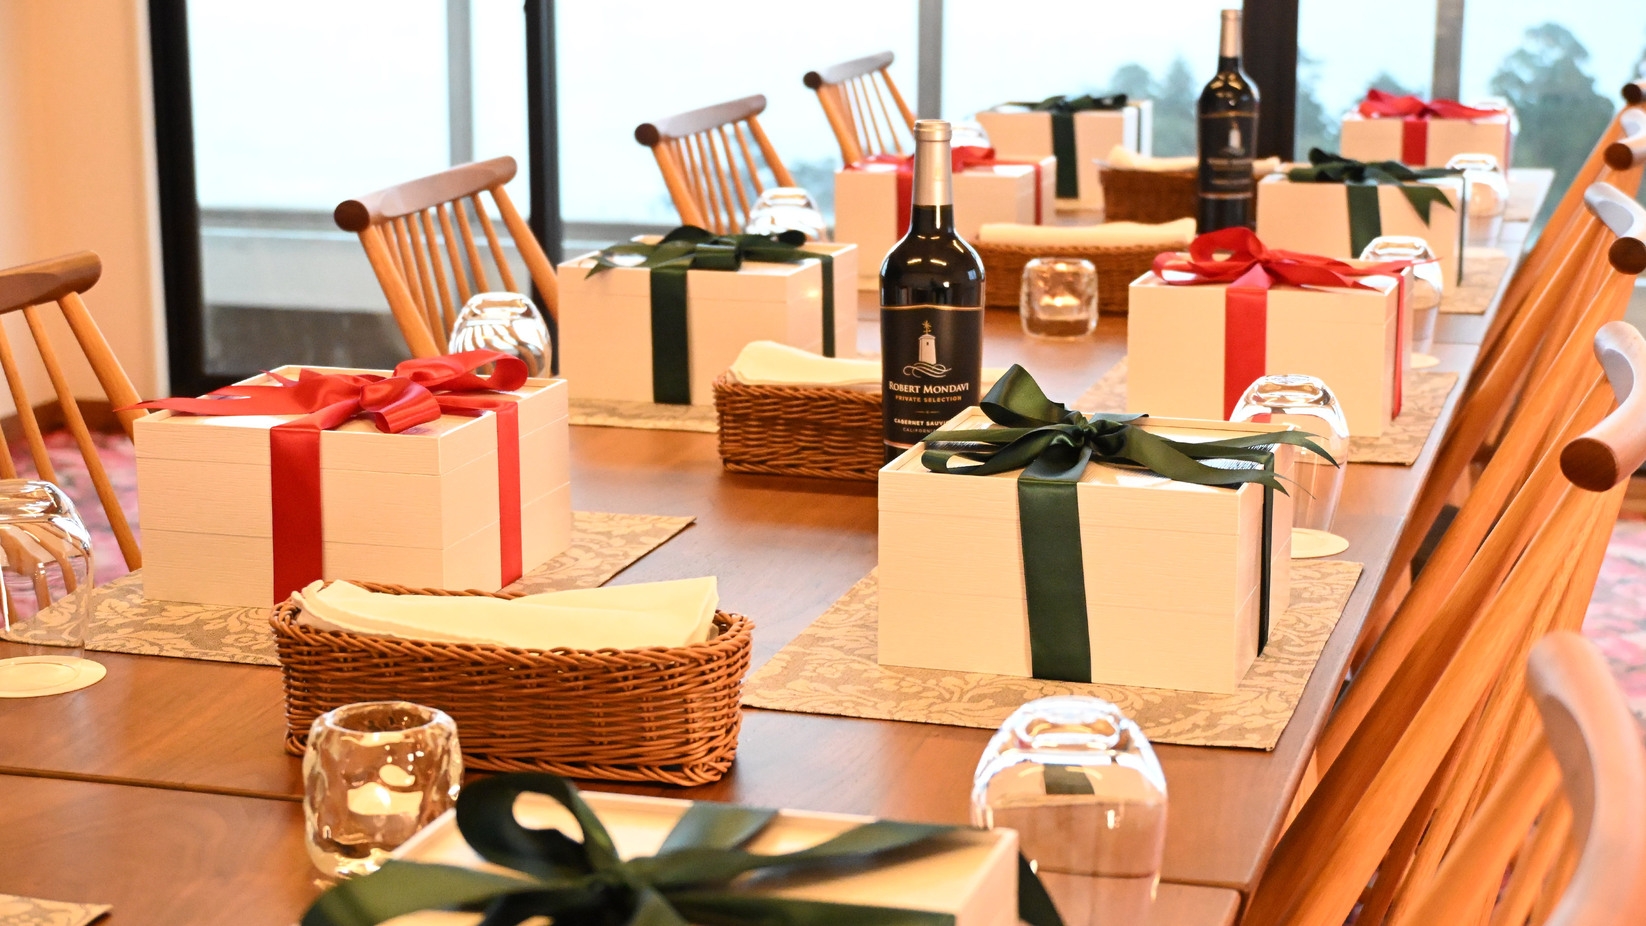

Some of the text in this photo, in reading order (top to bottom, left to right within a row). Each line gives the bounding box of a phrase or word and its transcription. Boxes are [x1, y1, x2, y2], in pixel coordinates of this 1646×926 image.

[888, 381, 969, 394] ROBERT MONDAVI
[894, 418, 924, 426] CABERNET
